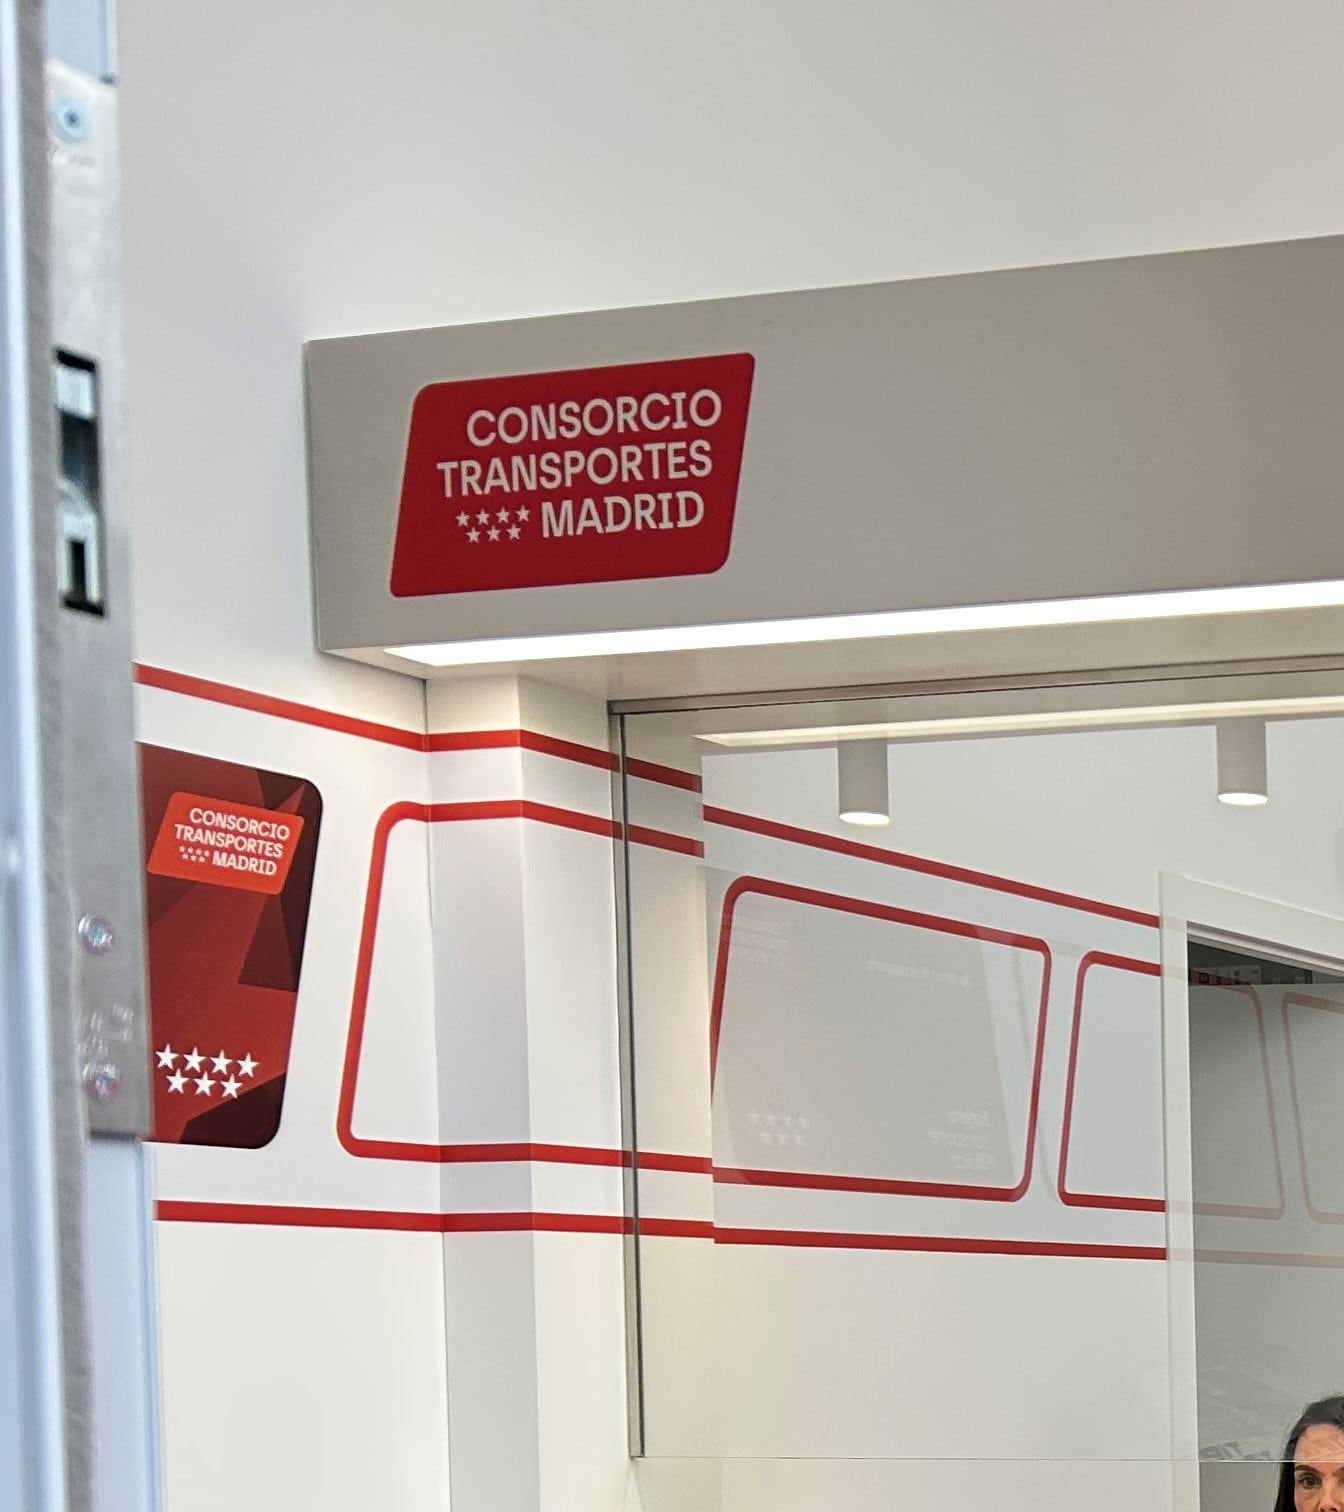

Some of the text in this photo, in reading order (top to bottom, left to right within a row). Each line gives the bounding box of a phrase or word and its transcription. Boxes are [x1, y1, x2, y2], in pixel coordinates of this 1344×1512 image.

[466, 388, 722, 447] CONSORCIO
[437, 439, 713, 498] TRANSPORTES
[541, 490, 705, 538] MADRID
[175, 824, 284, 859] TRANSPORTES
[189, 808, 290, 840] CONSORCIO
[212, 851, 277, 876] MADRID
